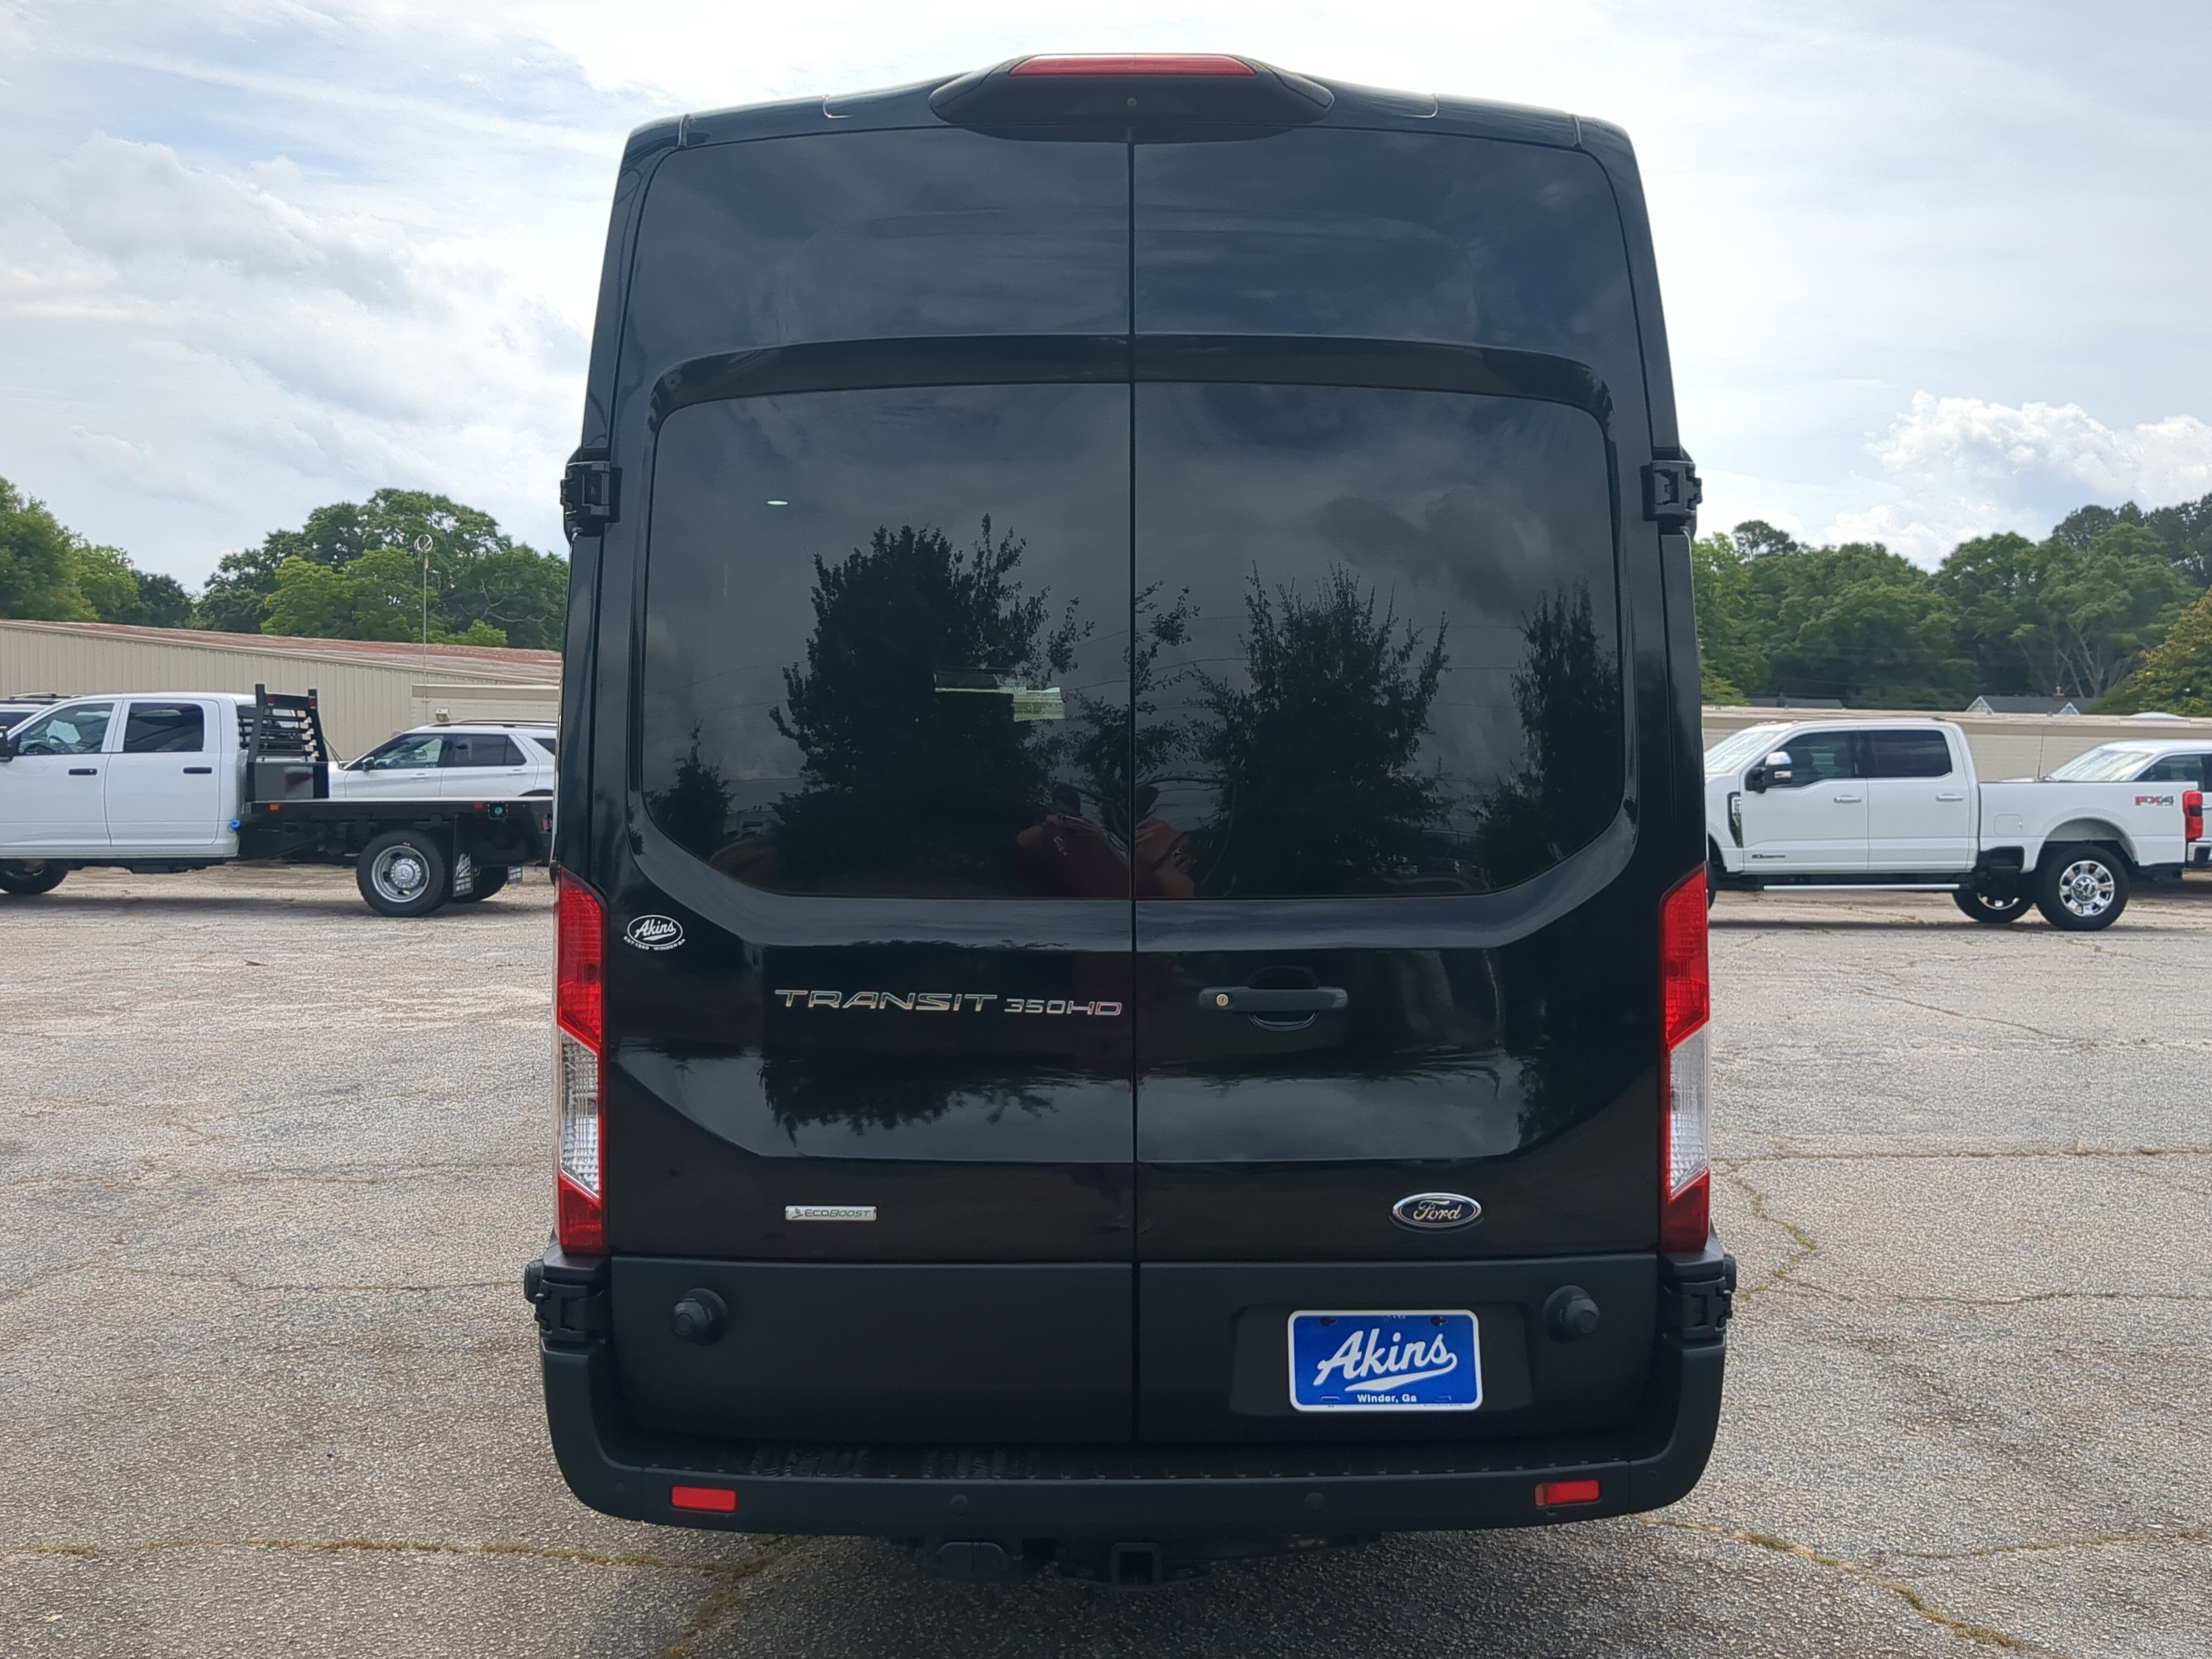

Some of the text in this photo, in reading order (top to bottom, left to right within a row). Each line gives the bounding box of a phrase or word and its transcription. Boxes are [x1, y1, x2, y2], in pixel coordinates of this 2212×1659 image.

[2135, 796, 2174, 806] FX4
[634, 918, 676, 941] Akins
[623, 936, 635, 945] EST
[775, 990, 1122, 1015] TRANSIT 350HD
[805, 1209, 871, 1217] ECOBOOST
[1413, 1200, 1463, 1221] Ford
[1313, 1328, 1458, 1391] Akins
[1357, 1394, 1417, 1403] Winder, Ga
